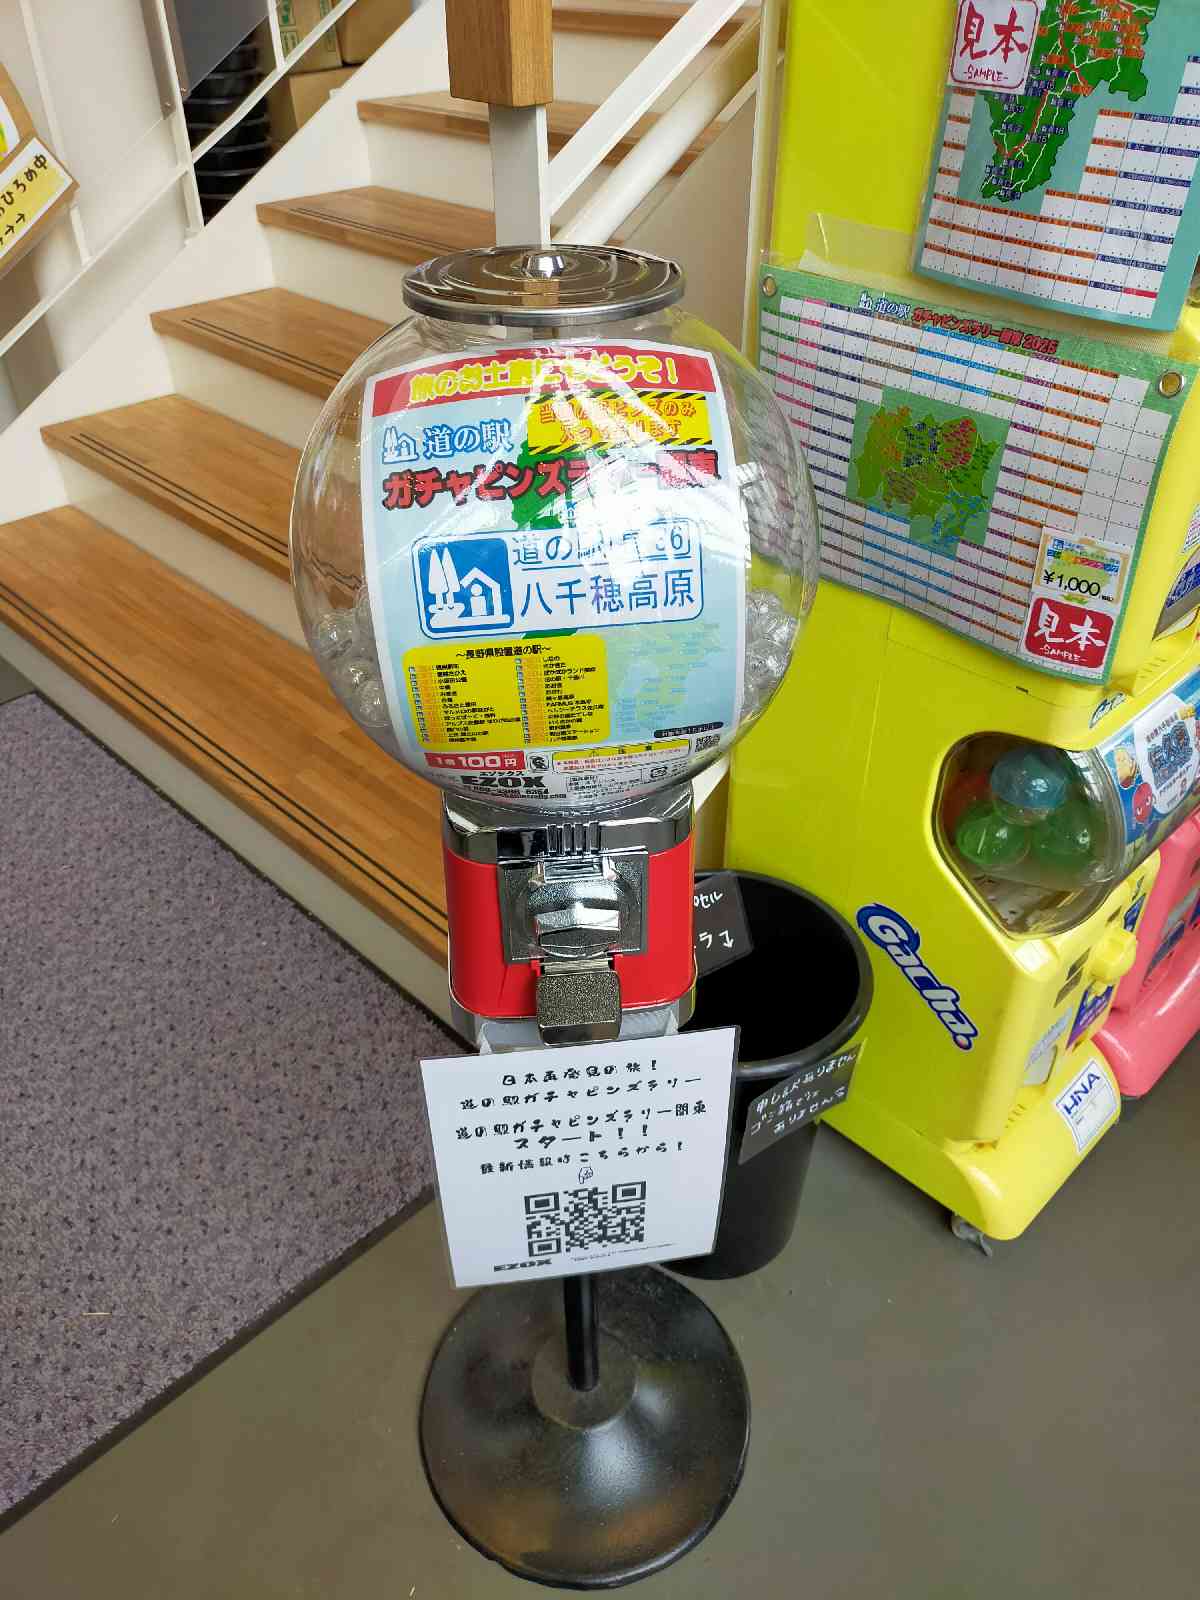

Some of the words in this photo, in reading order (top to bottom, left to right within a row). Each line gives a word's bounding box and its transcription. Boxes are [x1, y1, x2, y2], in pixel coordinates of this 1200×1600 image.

[959, 0, 1028, 64] 見本
[422, 417, 513, 458] 道の駅
[520, 569, 696, 619] 八千穂高原
[1042, 569, 1101, 597] ¥1,000
[1032, 600, 1107, 652] 見本
[460, 775, 547, 788] EZOX
